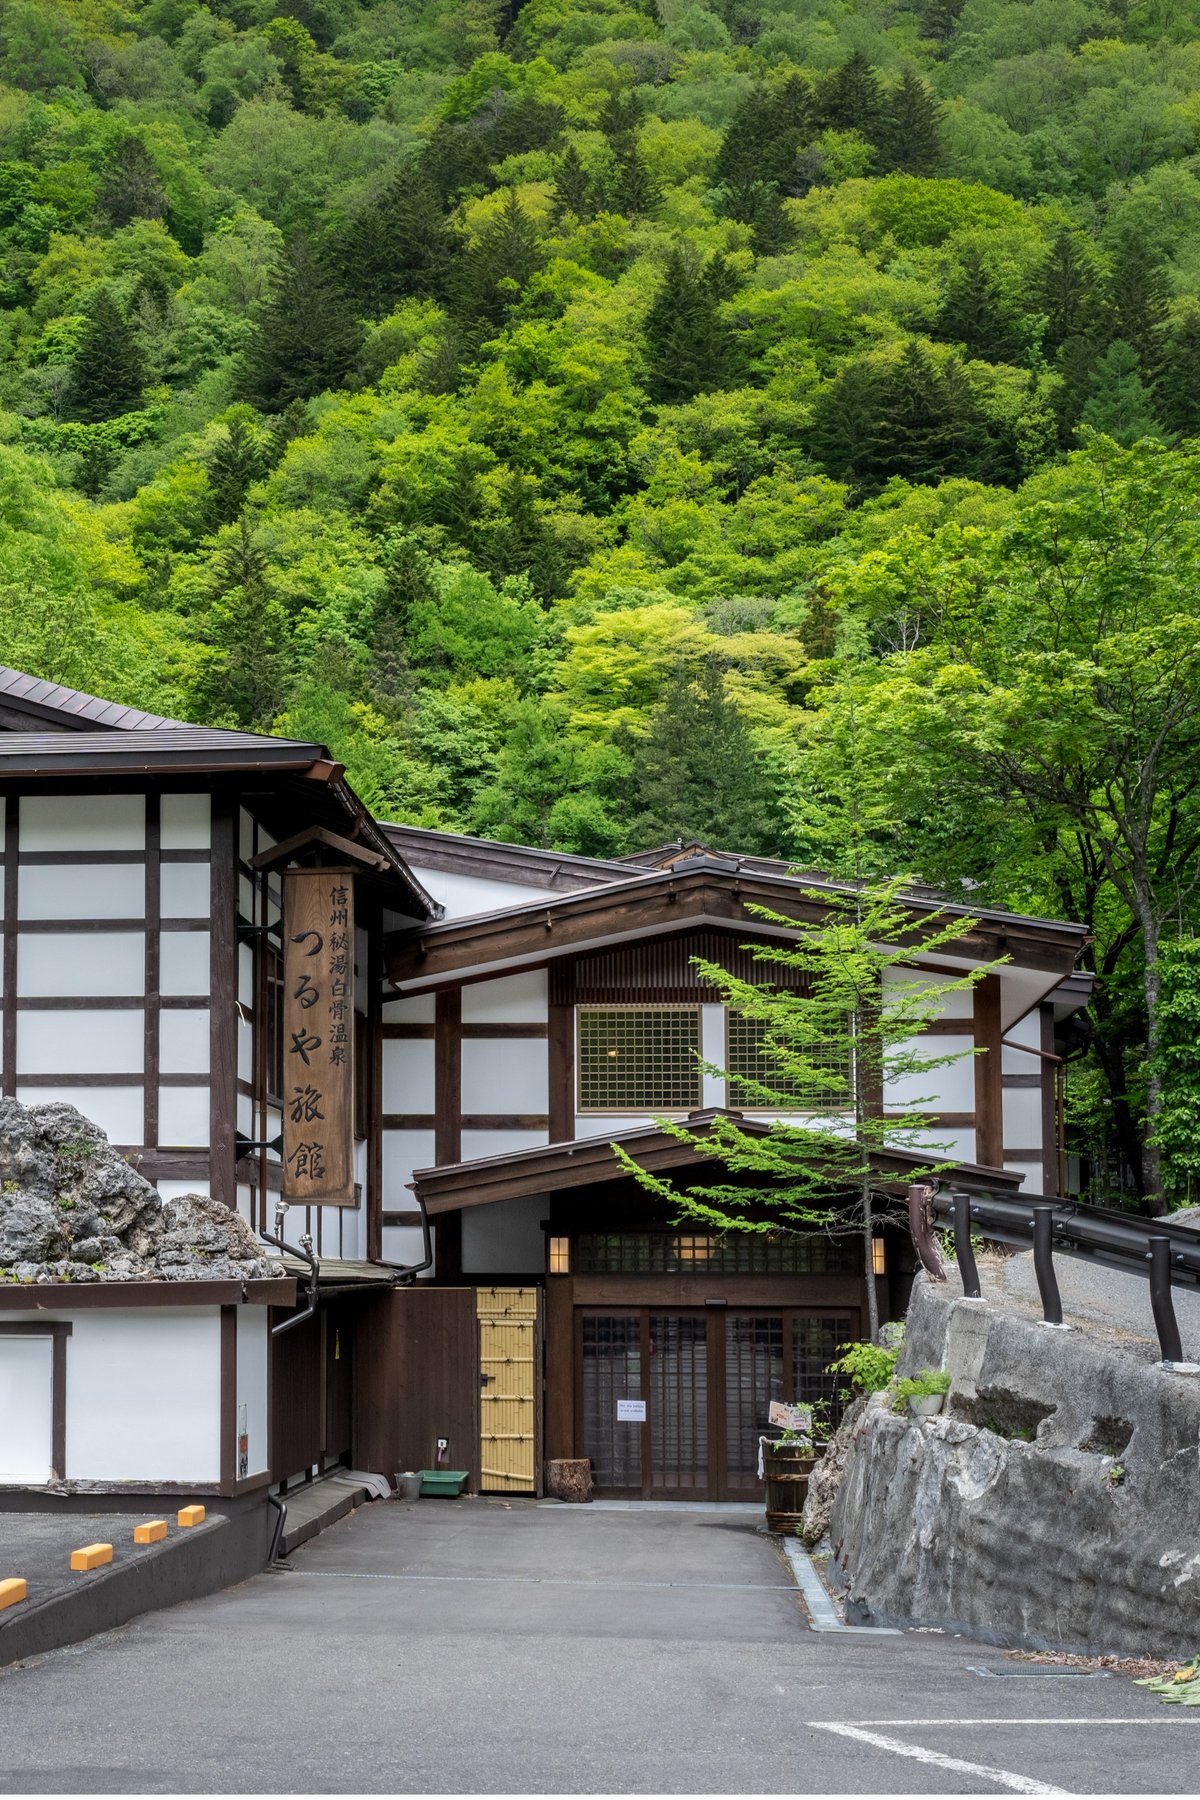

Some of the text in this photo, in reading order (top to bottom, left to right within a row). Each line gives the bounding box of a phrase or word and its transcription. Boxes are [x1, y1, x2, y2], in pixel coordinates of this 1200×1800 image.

[288, 930, 326, 1180] つるや旅館
[329, 885, 349, 1066] 信州秘湯白骨温泉
